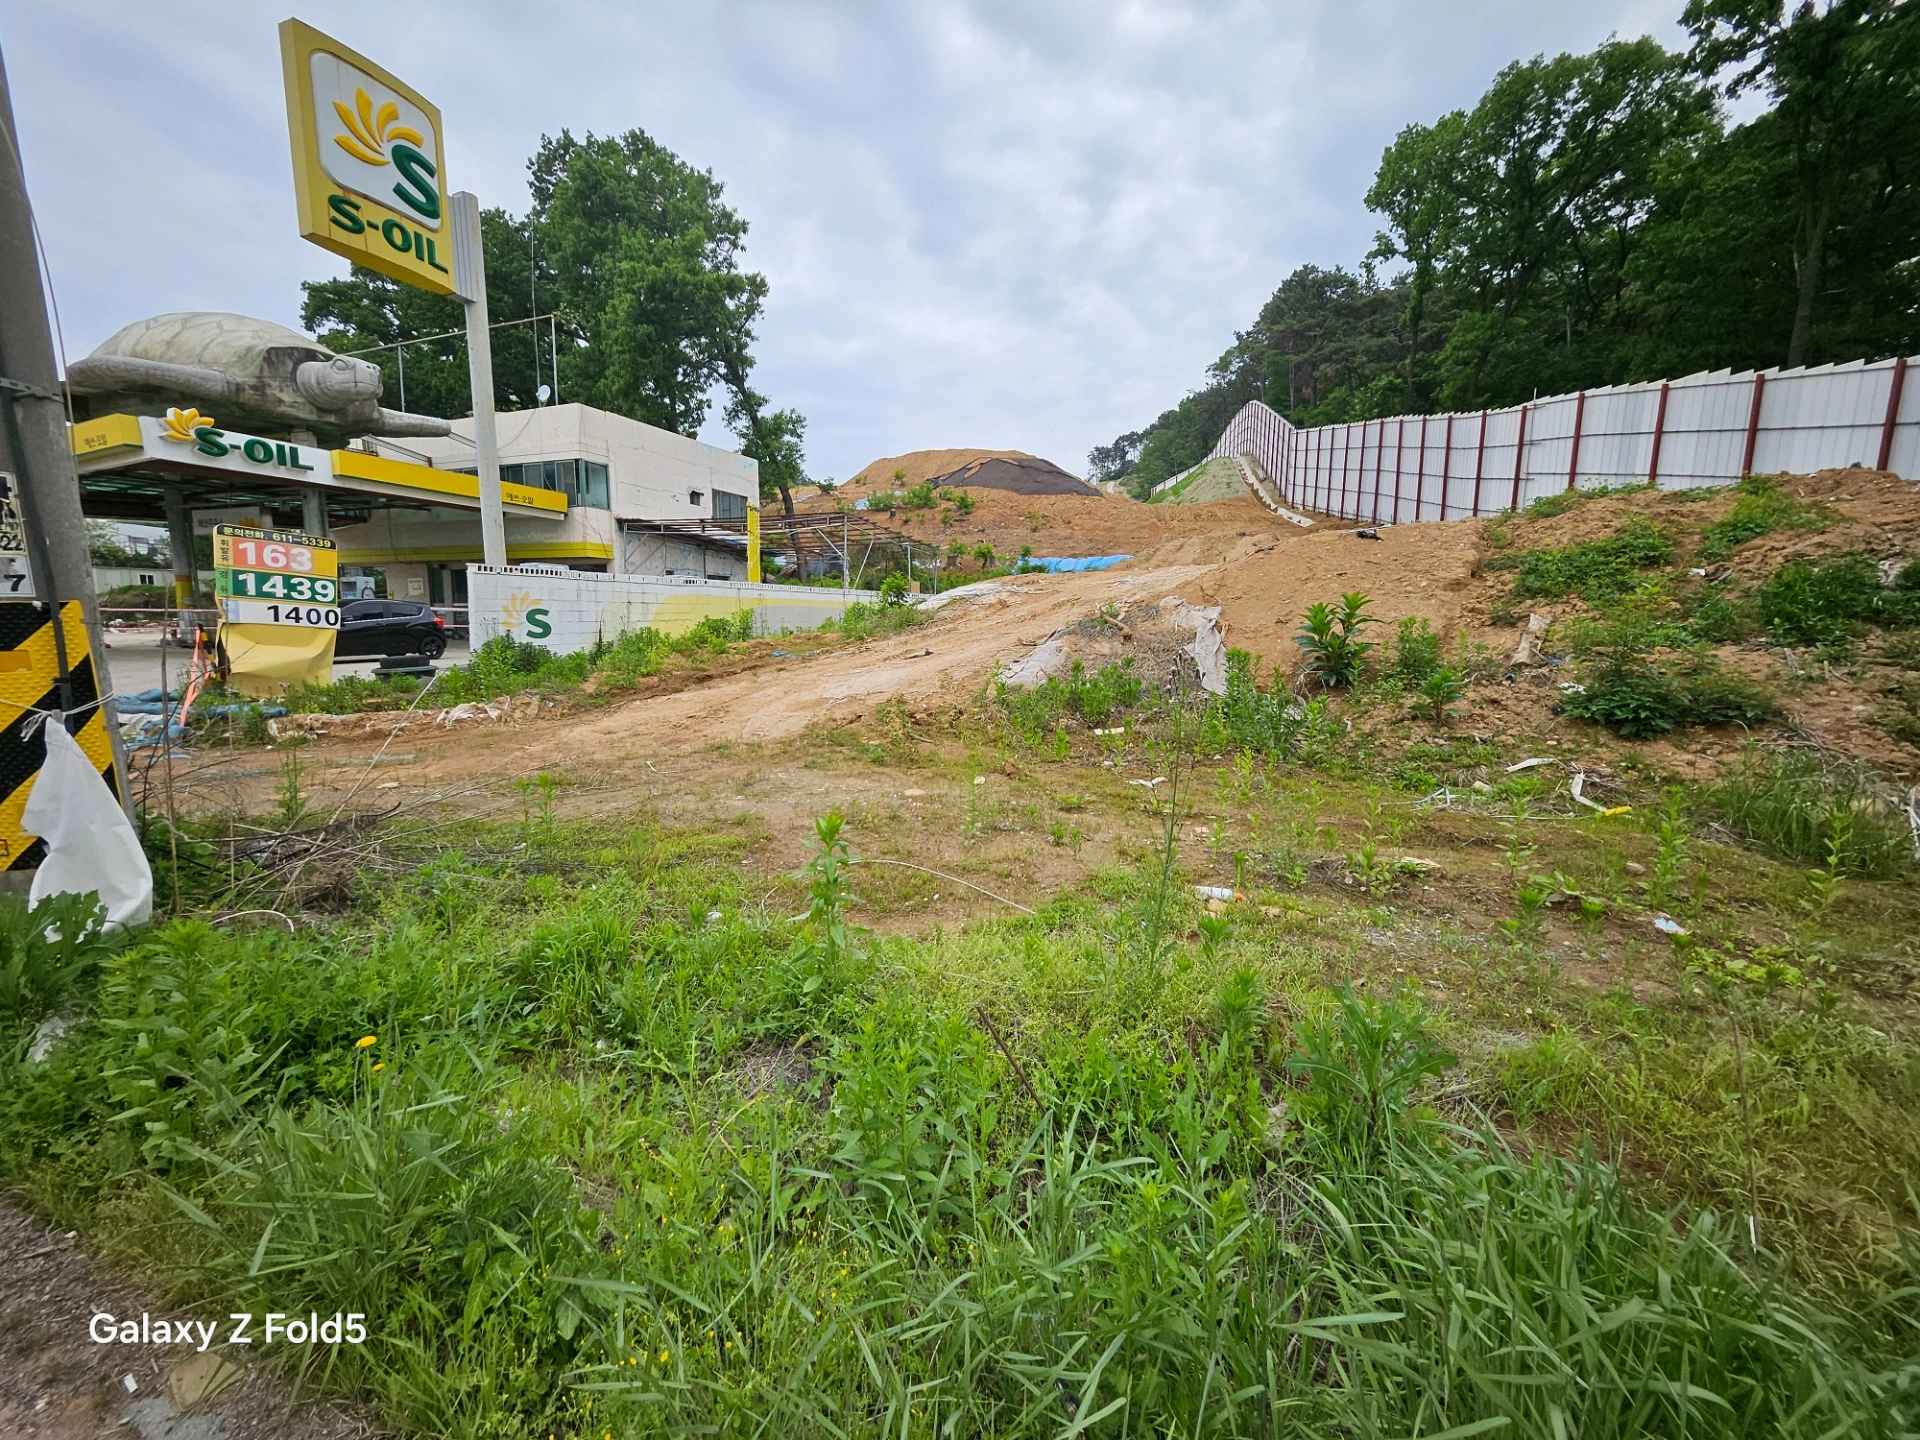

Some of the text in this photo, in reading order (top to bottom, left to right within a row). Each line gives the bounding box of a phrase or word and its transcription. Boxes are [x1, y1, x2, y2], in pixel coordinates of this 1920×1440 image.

[391, 144, 441, 219] S
[327, 194, 449, 275] S-OIL
[194, 426, 315, 472] S-OIL
[272, 533, 332, 548] 611-5339
[238, 541, 313, 572] 163
[238, 572, 335, 602] 1439
[267, 605, 340, 626] 1400
[525, 608, 552, 639] S
